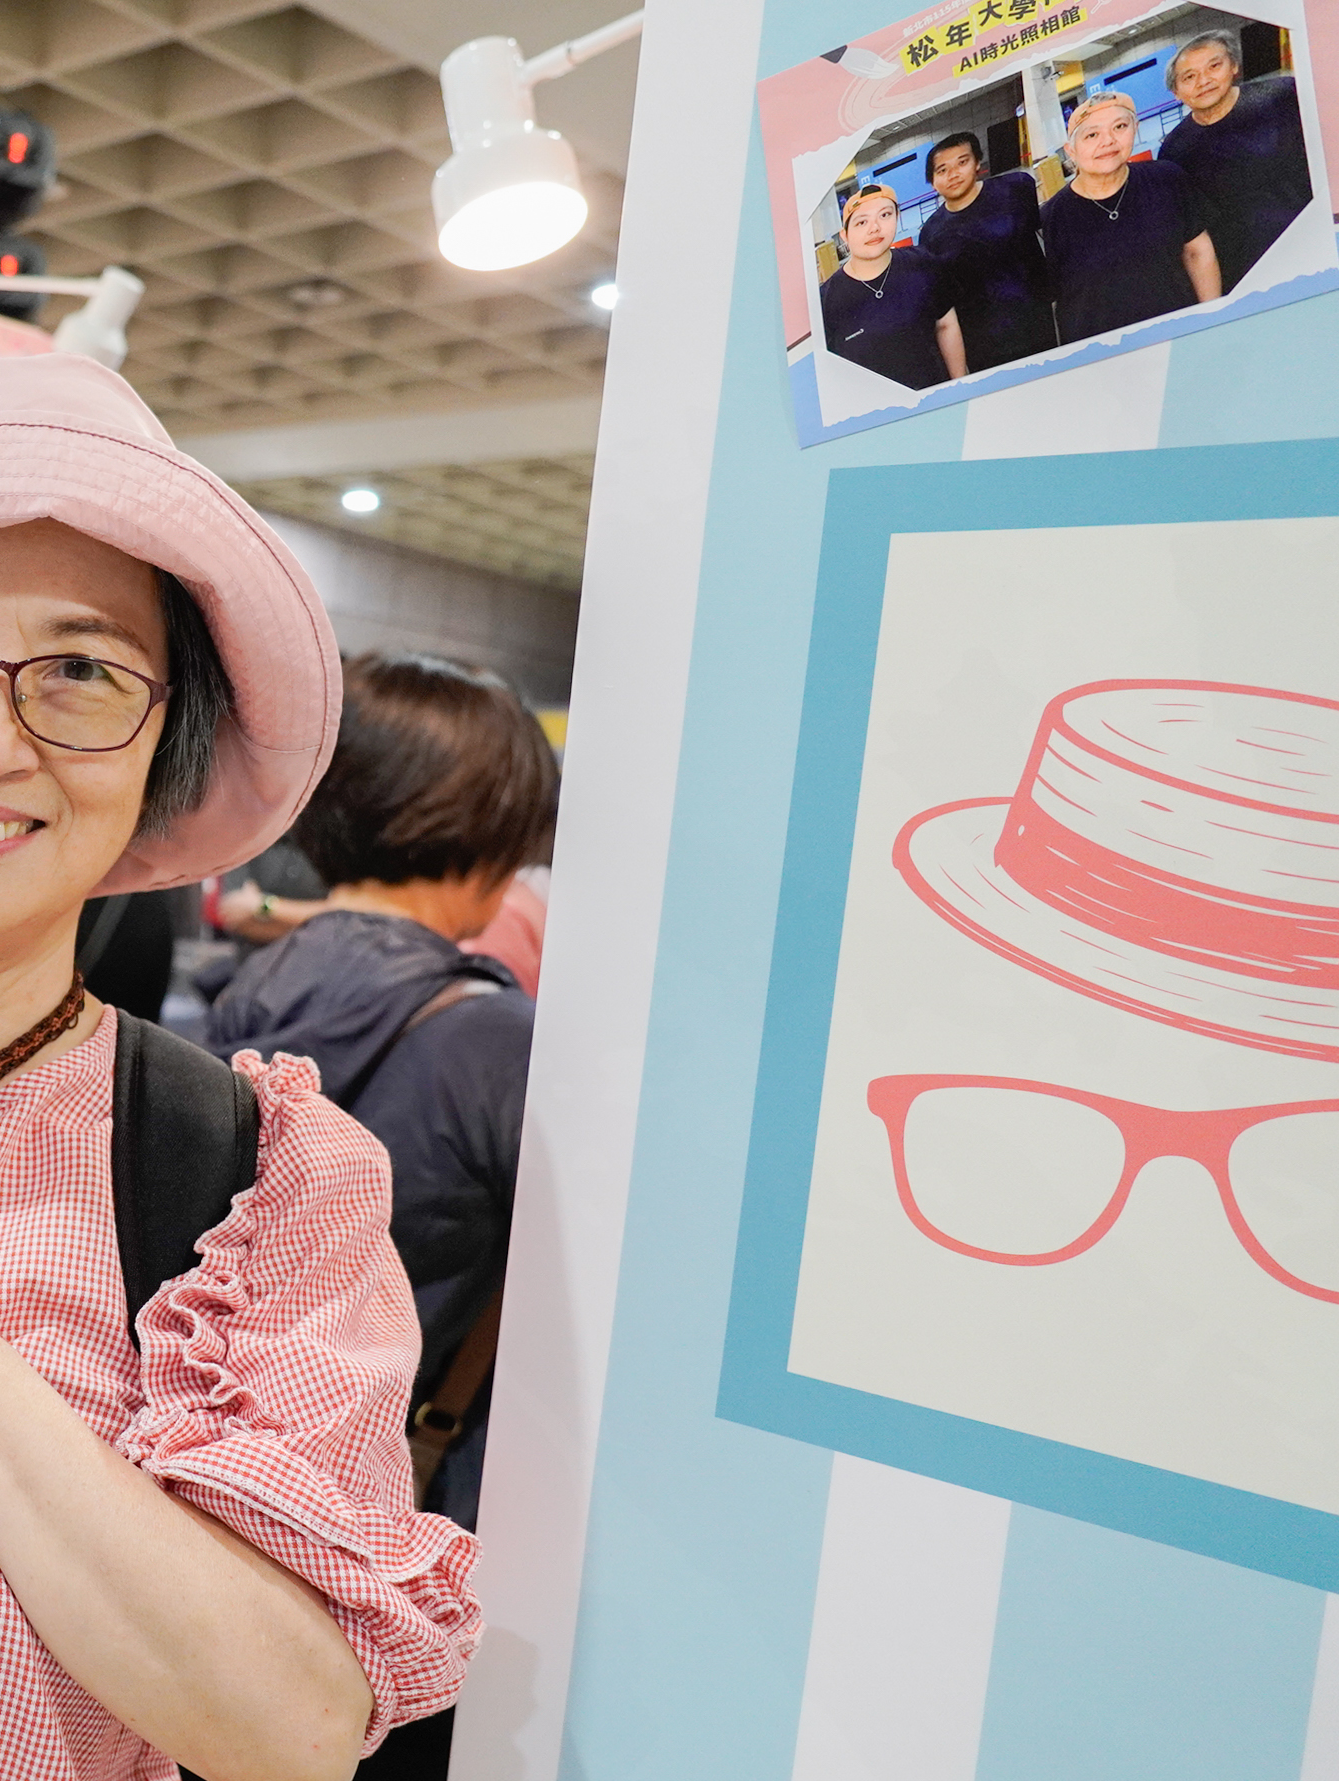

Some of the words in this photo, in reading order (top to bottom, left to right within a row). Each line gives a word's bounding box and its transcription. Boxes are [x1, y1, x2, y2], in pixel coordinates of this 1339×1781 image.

[907, 0, 1050, 67] 松年大學
[960, 6, 1081, 72] AI時光照相館
